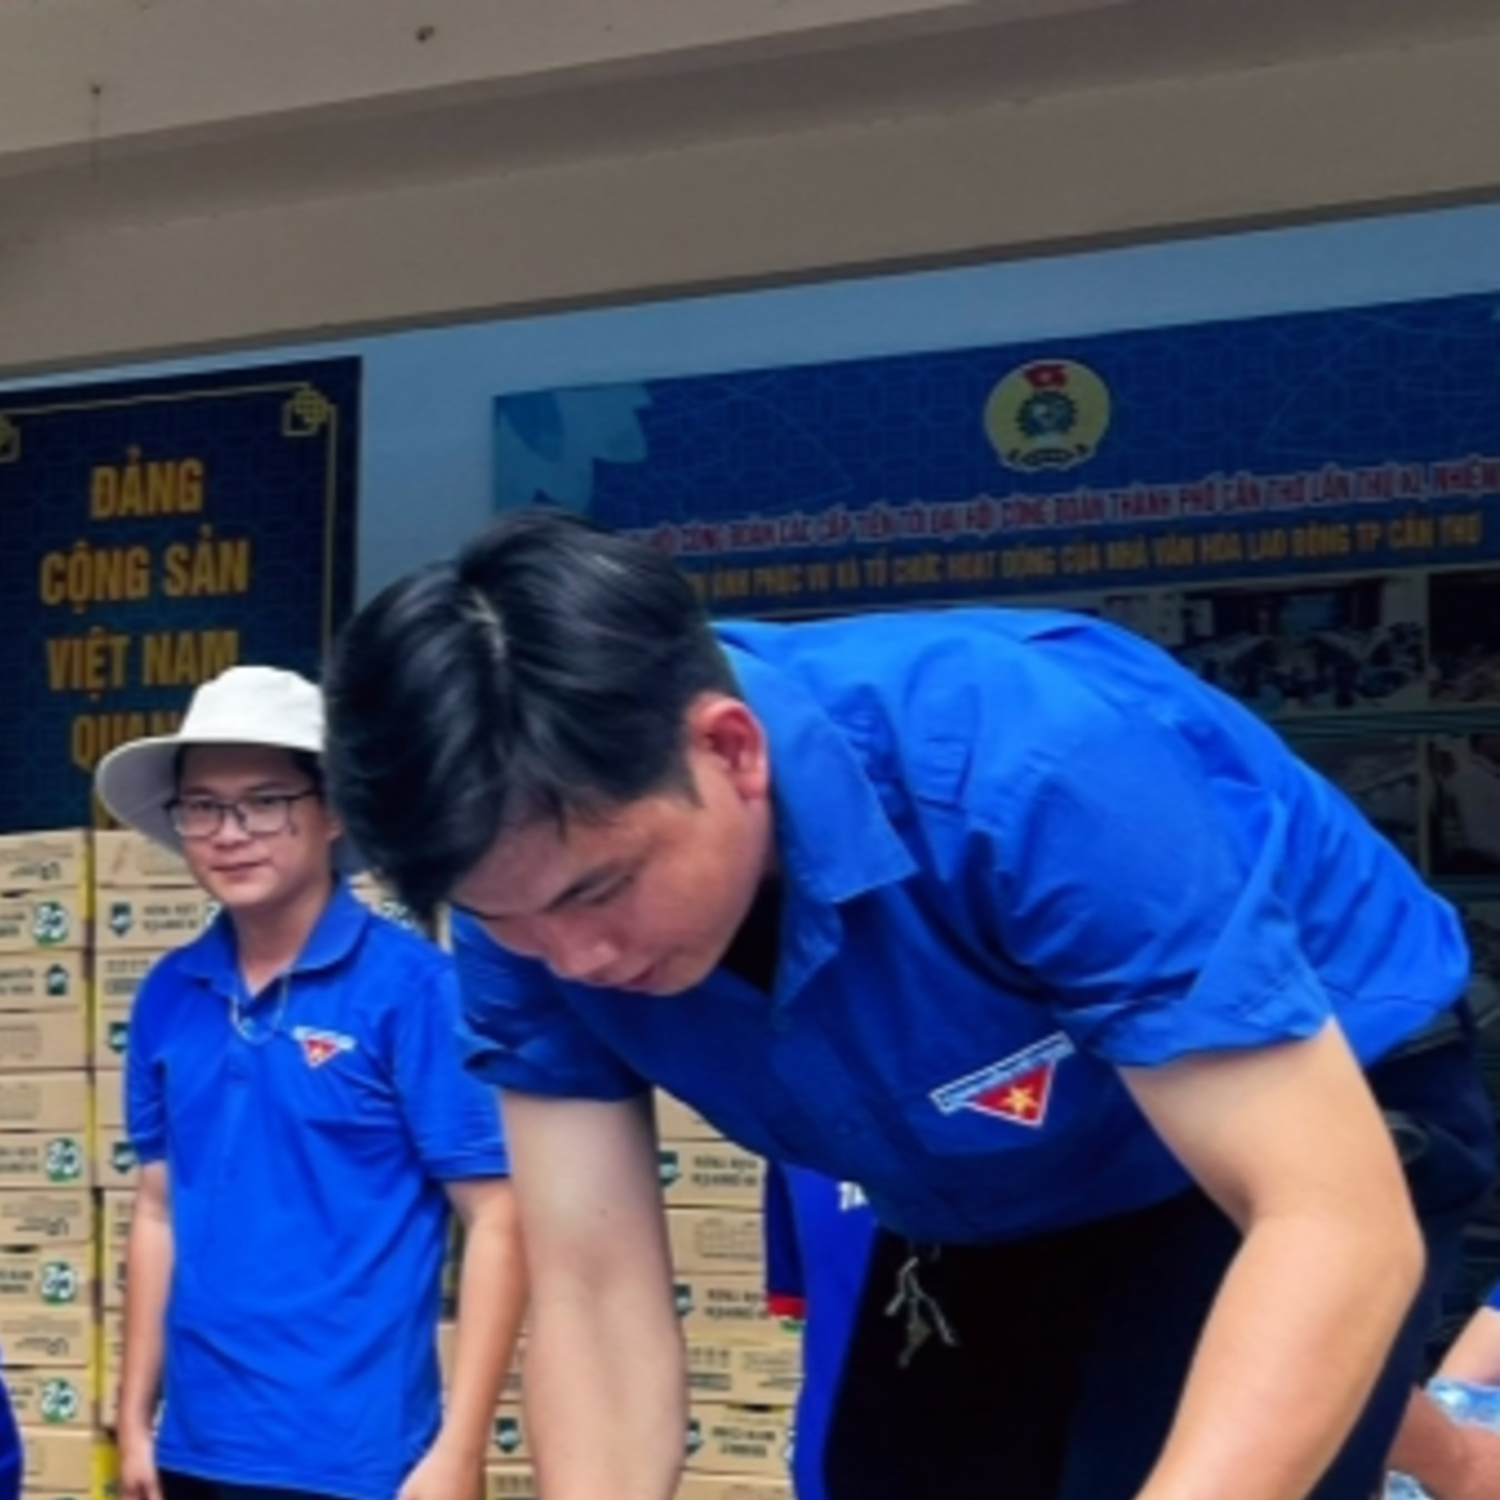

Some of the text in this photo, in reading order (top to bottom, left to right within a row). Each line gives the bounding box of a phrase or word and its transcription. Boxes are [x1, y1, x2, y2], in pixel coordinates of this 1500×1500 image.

[89, 445, 204, 520] ĐẢNG
[40, 524, 249, 615] CỘNG SẢN
[1354, 521, 1382, 553] TP
[47, 625, 239, 701] VIỆT NAM
